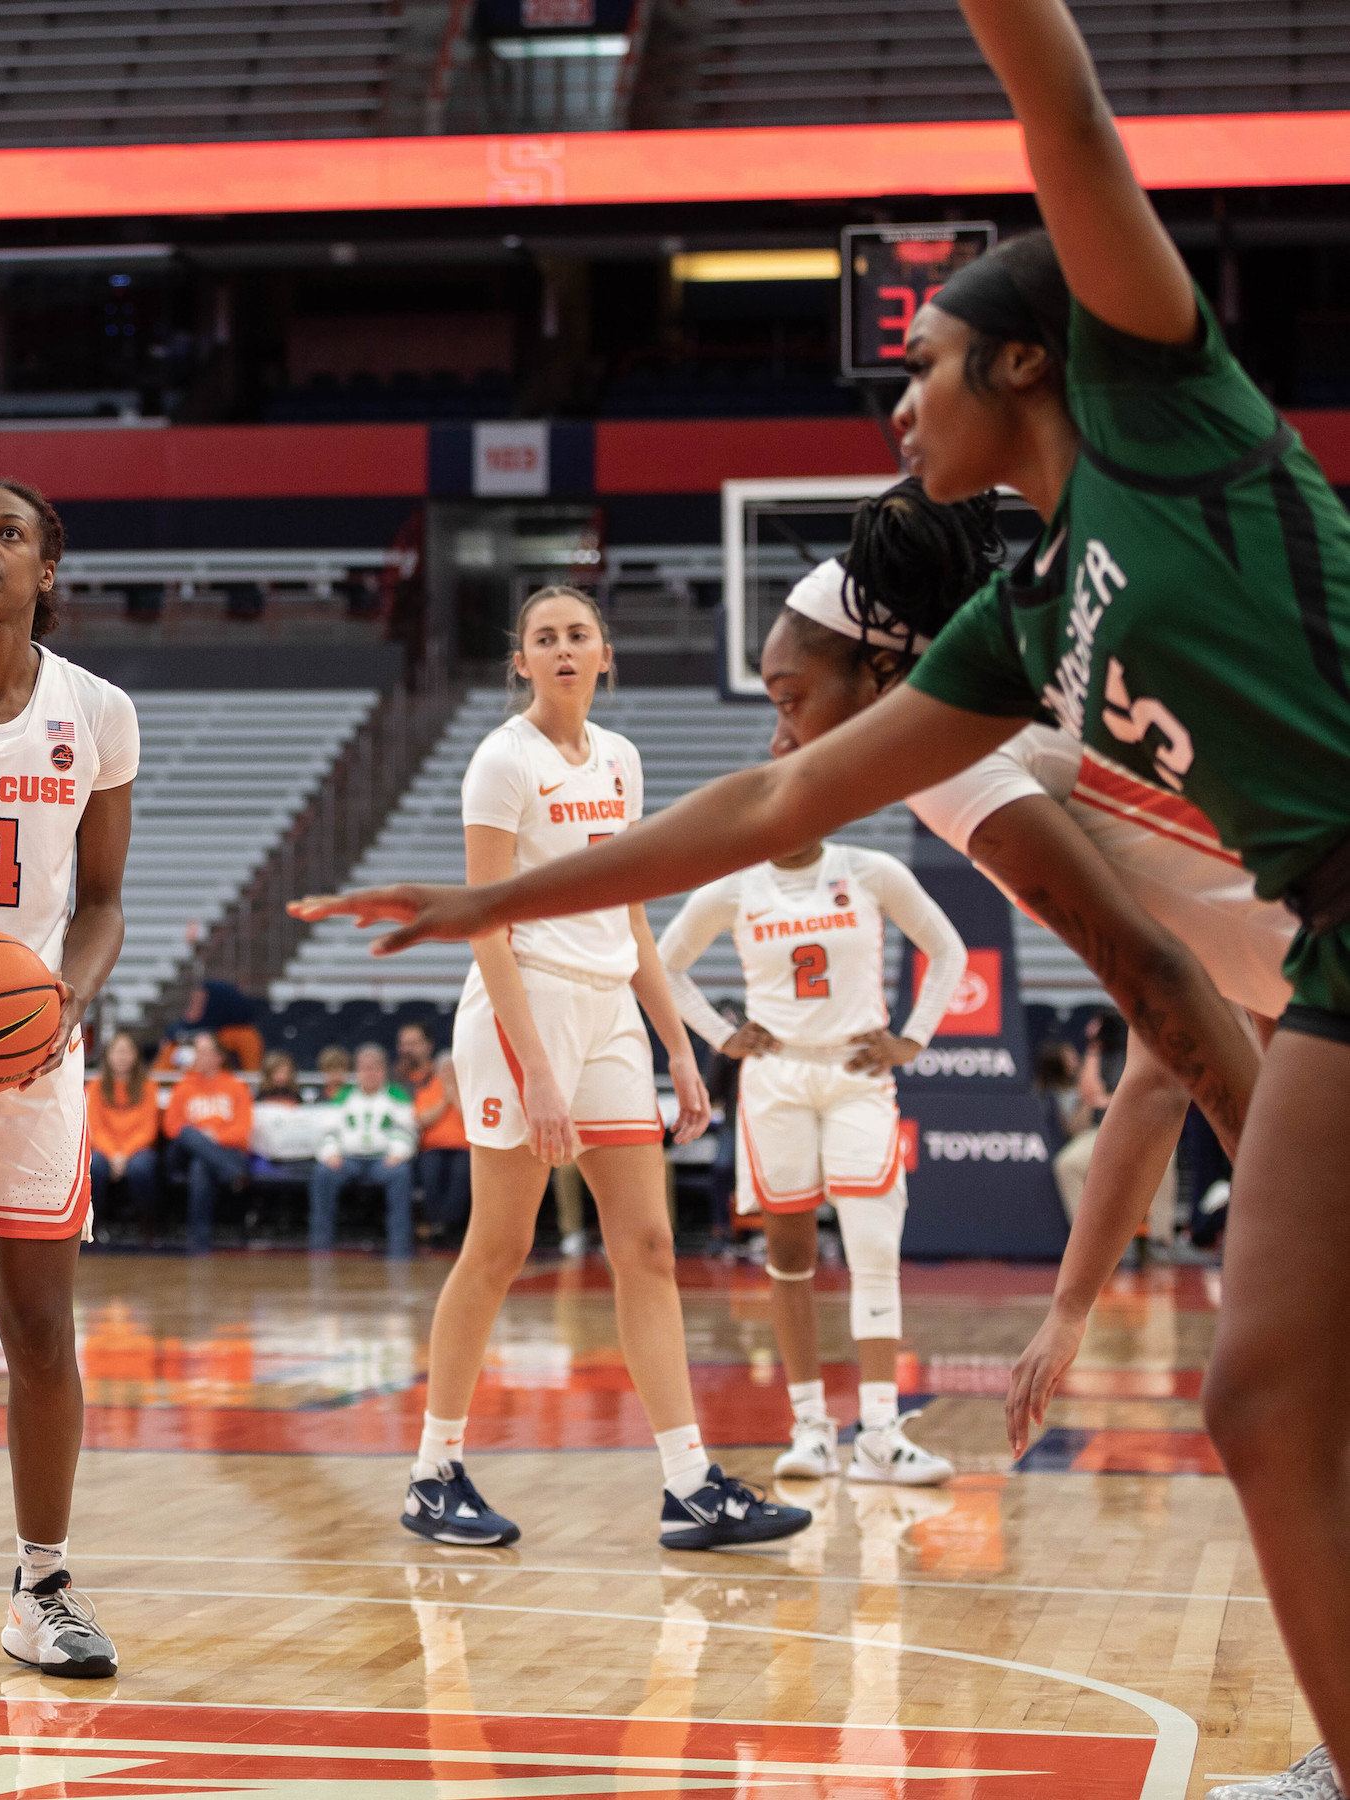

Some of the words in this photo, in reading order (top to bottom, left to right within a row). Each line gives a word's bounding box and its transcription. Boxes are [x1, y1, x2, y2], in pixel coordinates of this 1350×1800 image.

[753, 911, 858, 942] SYRACUSE
[791, 943, 830, 999] 2
[482, 1097, 502, 1128] S
[923, 1130, 1049, 1163] TOYOTA
